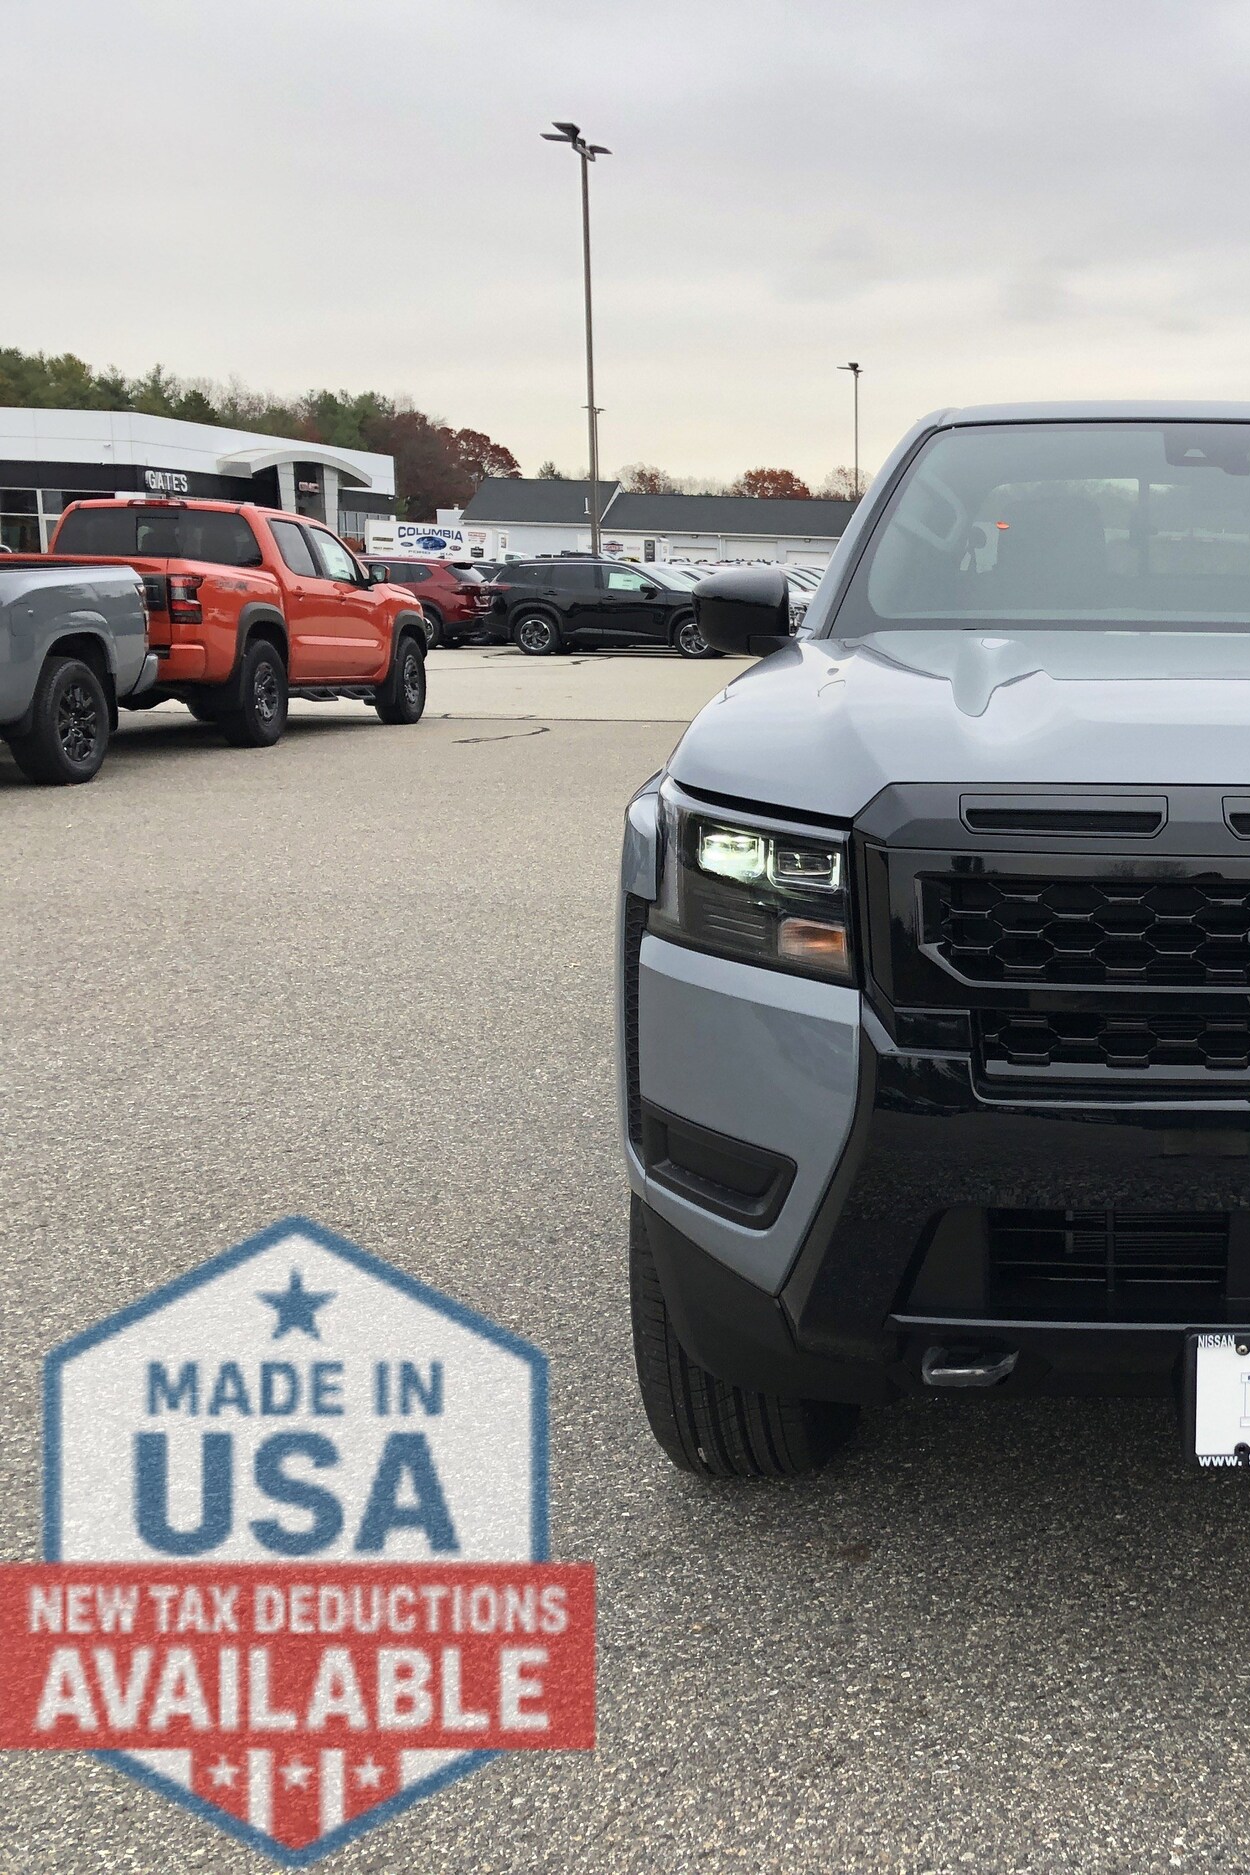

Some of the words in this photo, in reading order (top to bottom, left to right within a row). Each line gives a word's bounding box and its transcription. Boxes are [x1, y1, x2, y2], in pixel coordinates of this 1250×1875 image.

[145, 470, 188, 493] GATES
[398, 526, 463, 543] COLUMBIA
[1198, 1335, 1235, 1348] NISSAN
